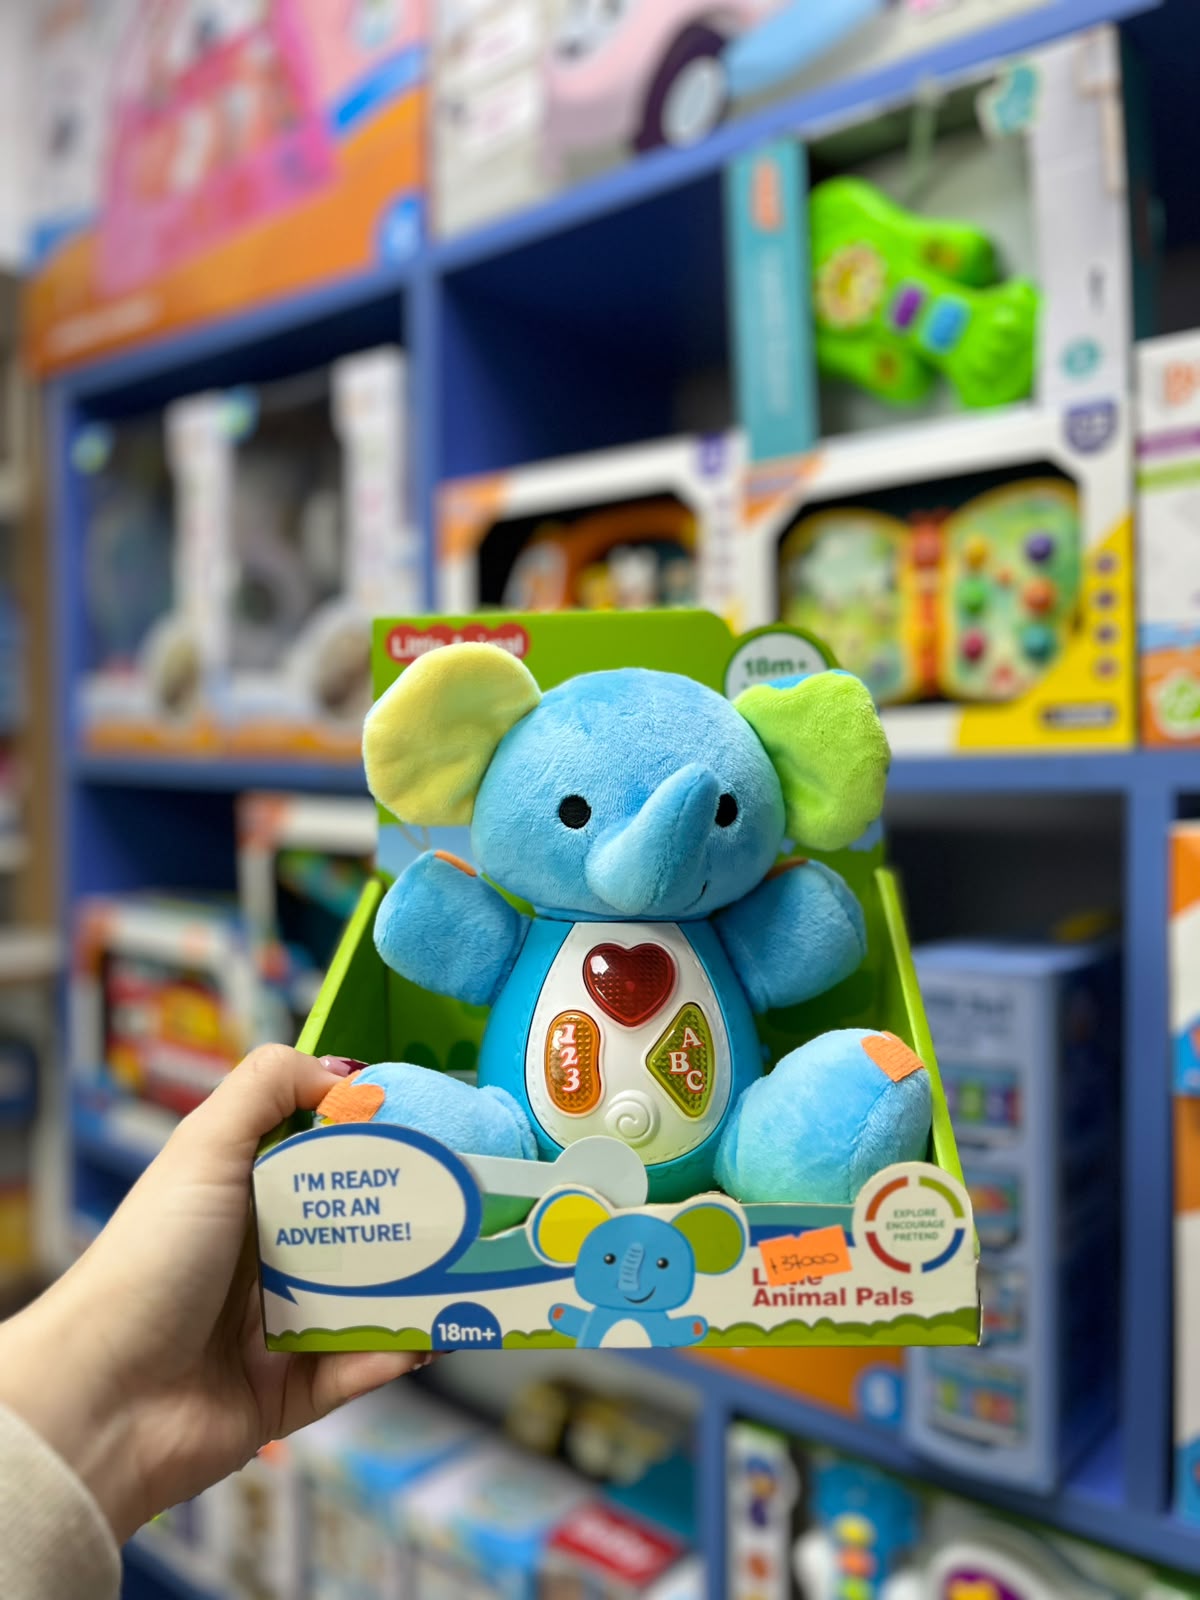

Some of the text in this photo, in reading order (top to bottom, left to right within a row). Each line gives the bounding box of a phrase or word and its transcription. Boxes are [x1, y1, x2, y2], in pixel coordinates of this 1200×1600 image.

[293, 1168, 400, 1193] I'M READY
[302, 1197, 381, 1219] FOR AN
[893, 1208, 937, 1219] EXPLORE
[275, 1222, 412, 1246] ADVENTURE!
[886, 1219, 945, 1231] ENCOURAGE
[893, 1231, 938, 1241] PRETEND
[752, 1286, 914, 1307] Animal Pals
[438, 1323, 496, 1342] 18m+
